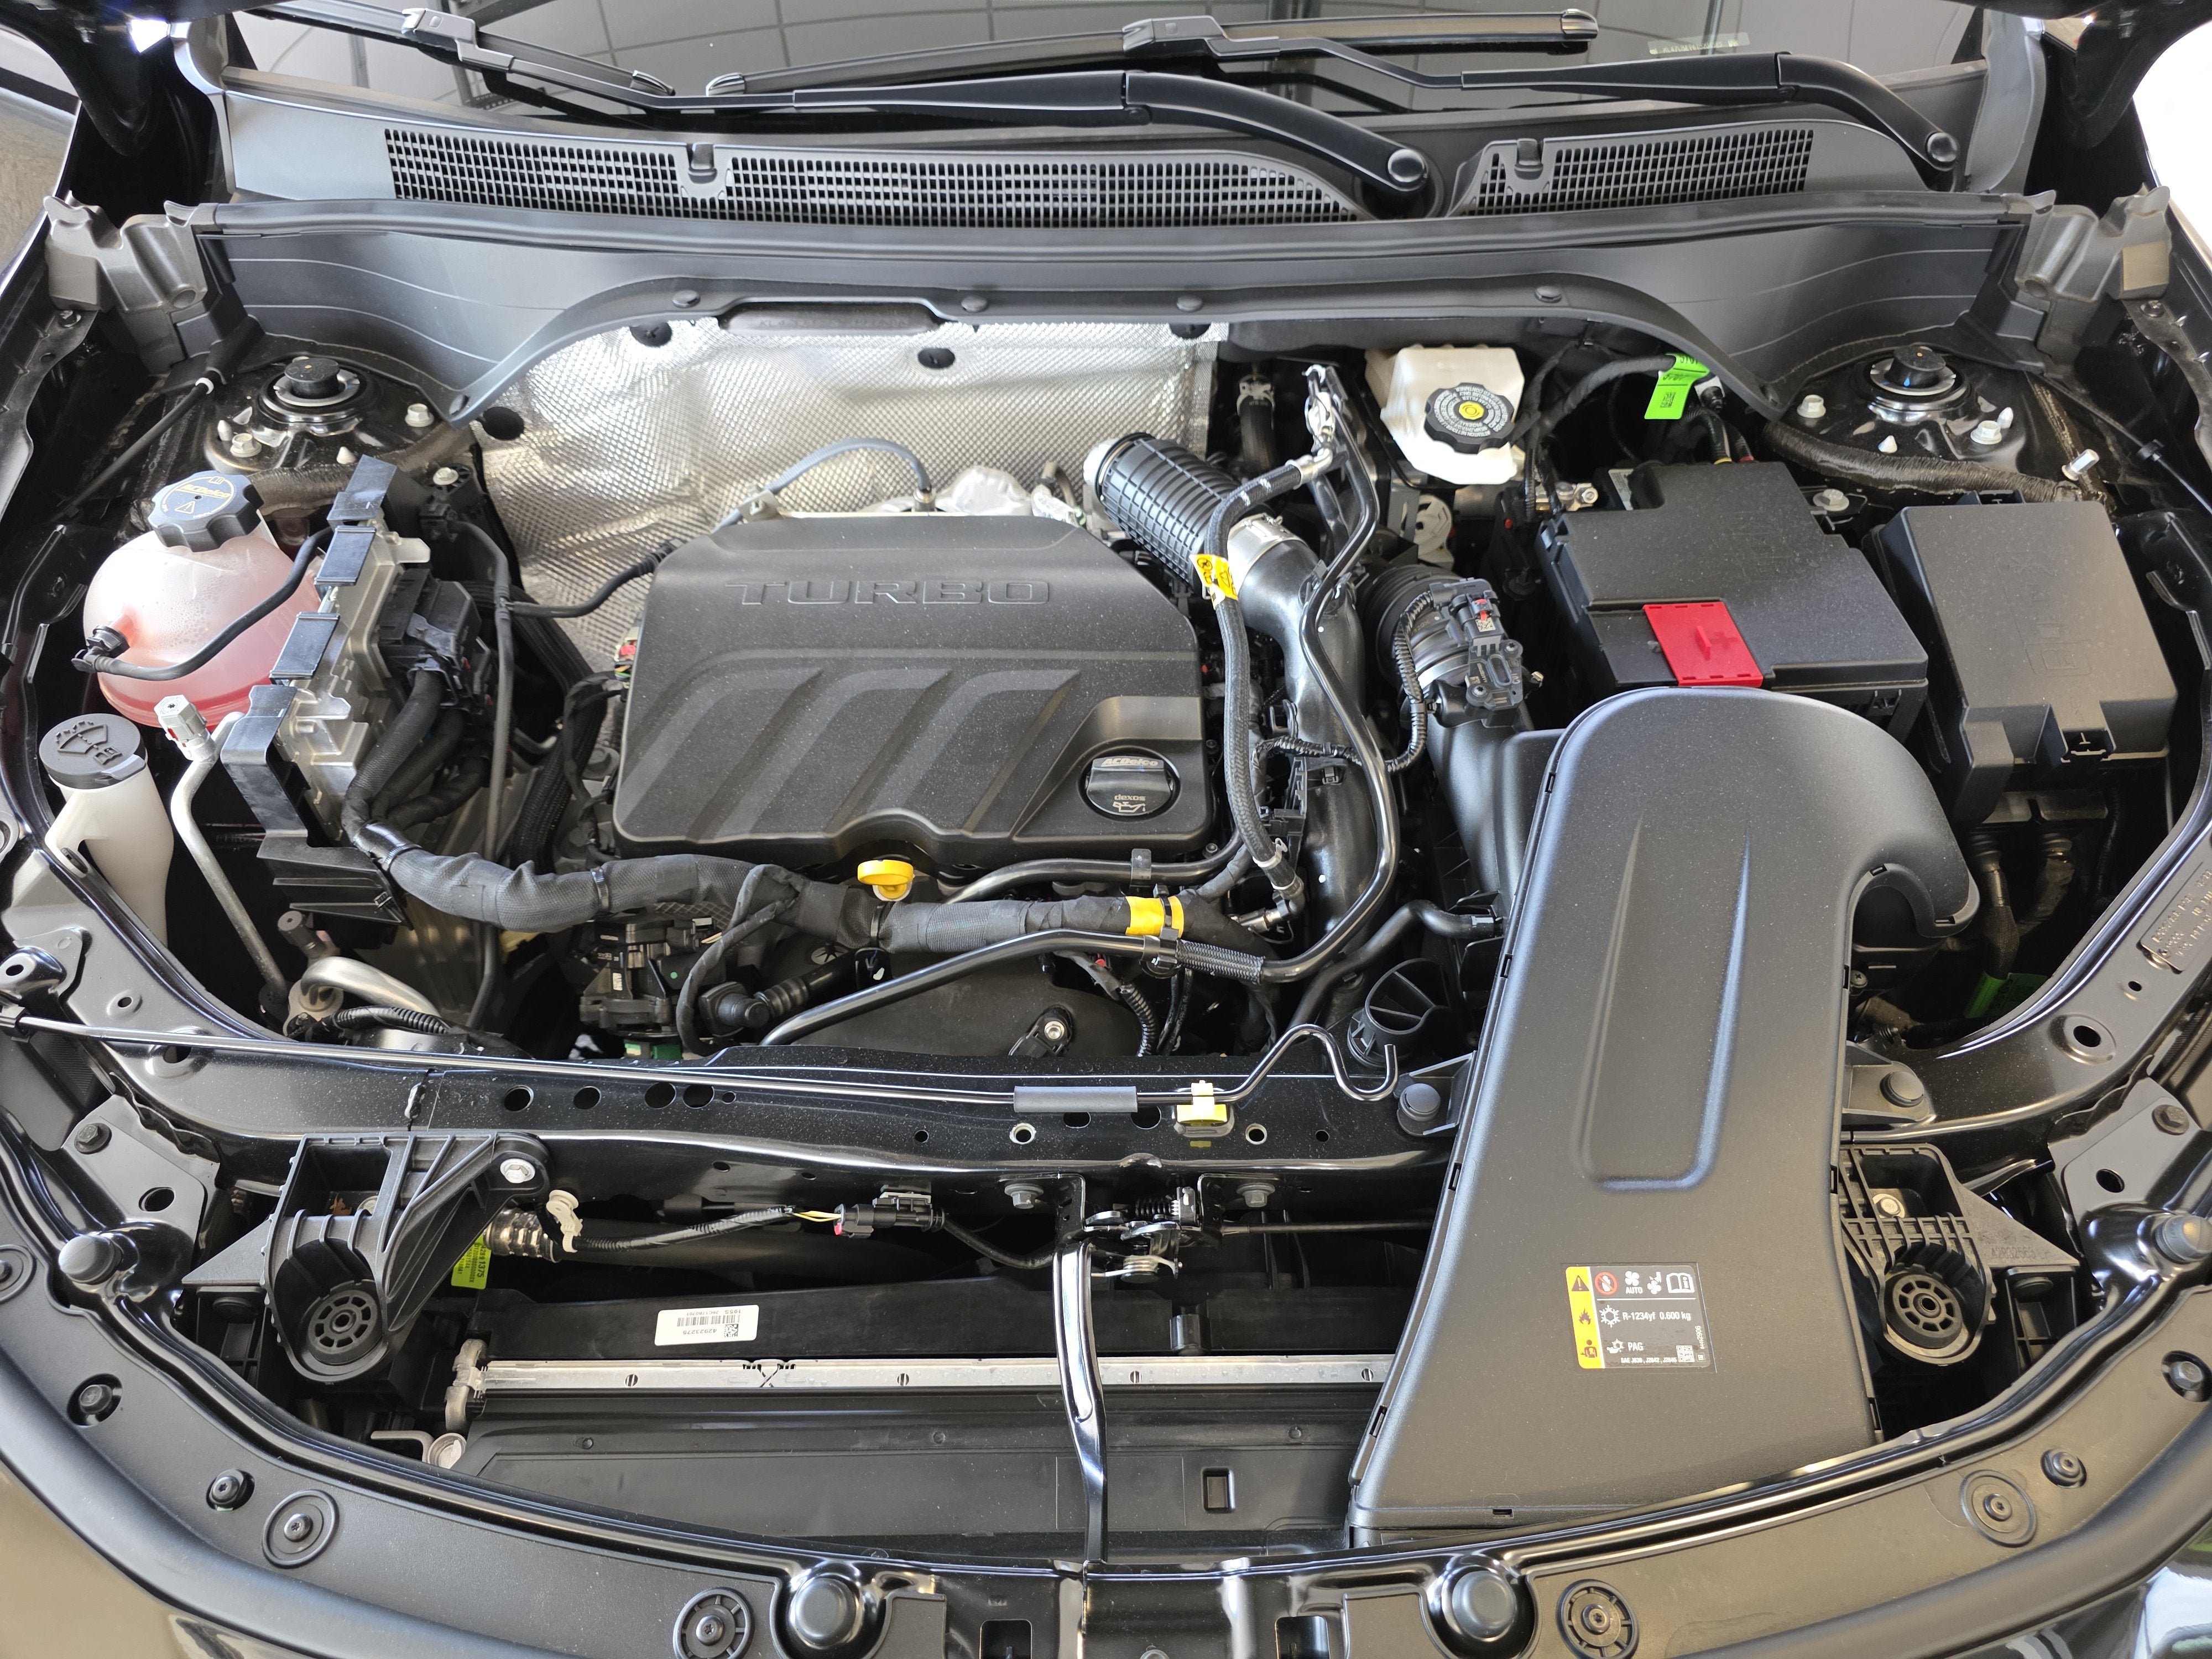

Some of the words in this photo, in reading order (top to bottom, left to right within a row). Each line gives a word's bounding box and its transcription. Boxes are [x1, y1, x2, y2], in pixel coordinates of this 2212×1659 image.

[1455, 385, 1483, 394] CONTAINER
[181, 484, 232, 498] ACDelco
[724, 580, 1051, 605] TURBO
[1101, 758, 1159, 766] ACDelco
[1622, 1312, 1656, 1322] R-1234yf
[1659, 1312, 1679, 1320] 0.600
[1681, 1312, 1691, 1321] kg
[1627, 1342, 1644, 1351] PAG
